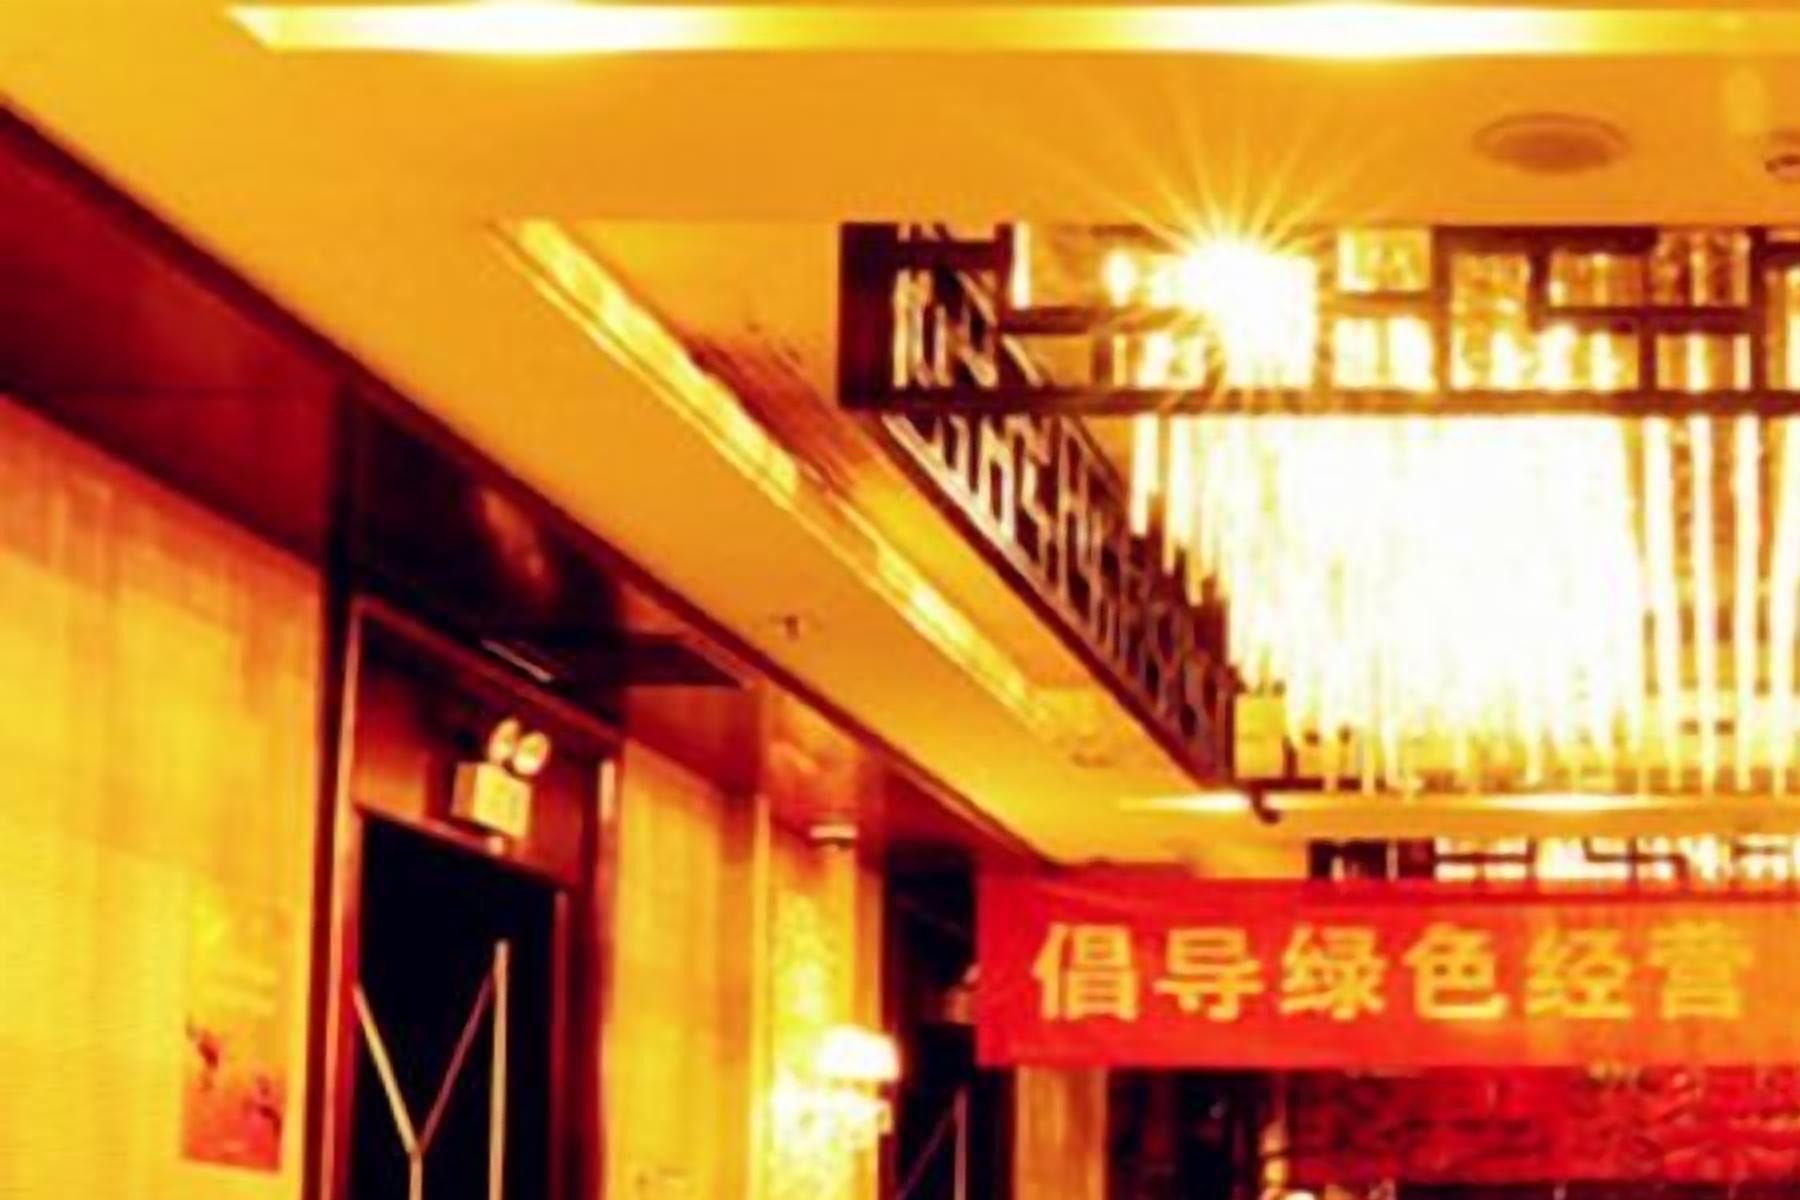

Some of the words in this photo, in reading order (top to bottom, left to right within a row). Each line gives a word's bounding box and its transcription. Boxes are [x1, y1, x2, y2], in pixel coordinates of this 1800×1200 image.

[1031, 919, 1756, 1022] 倡导绿色经营
